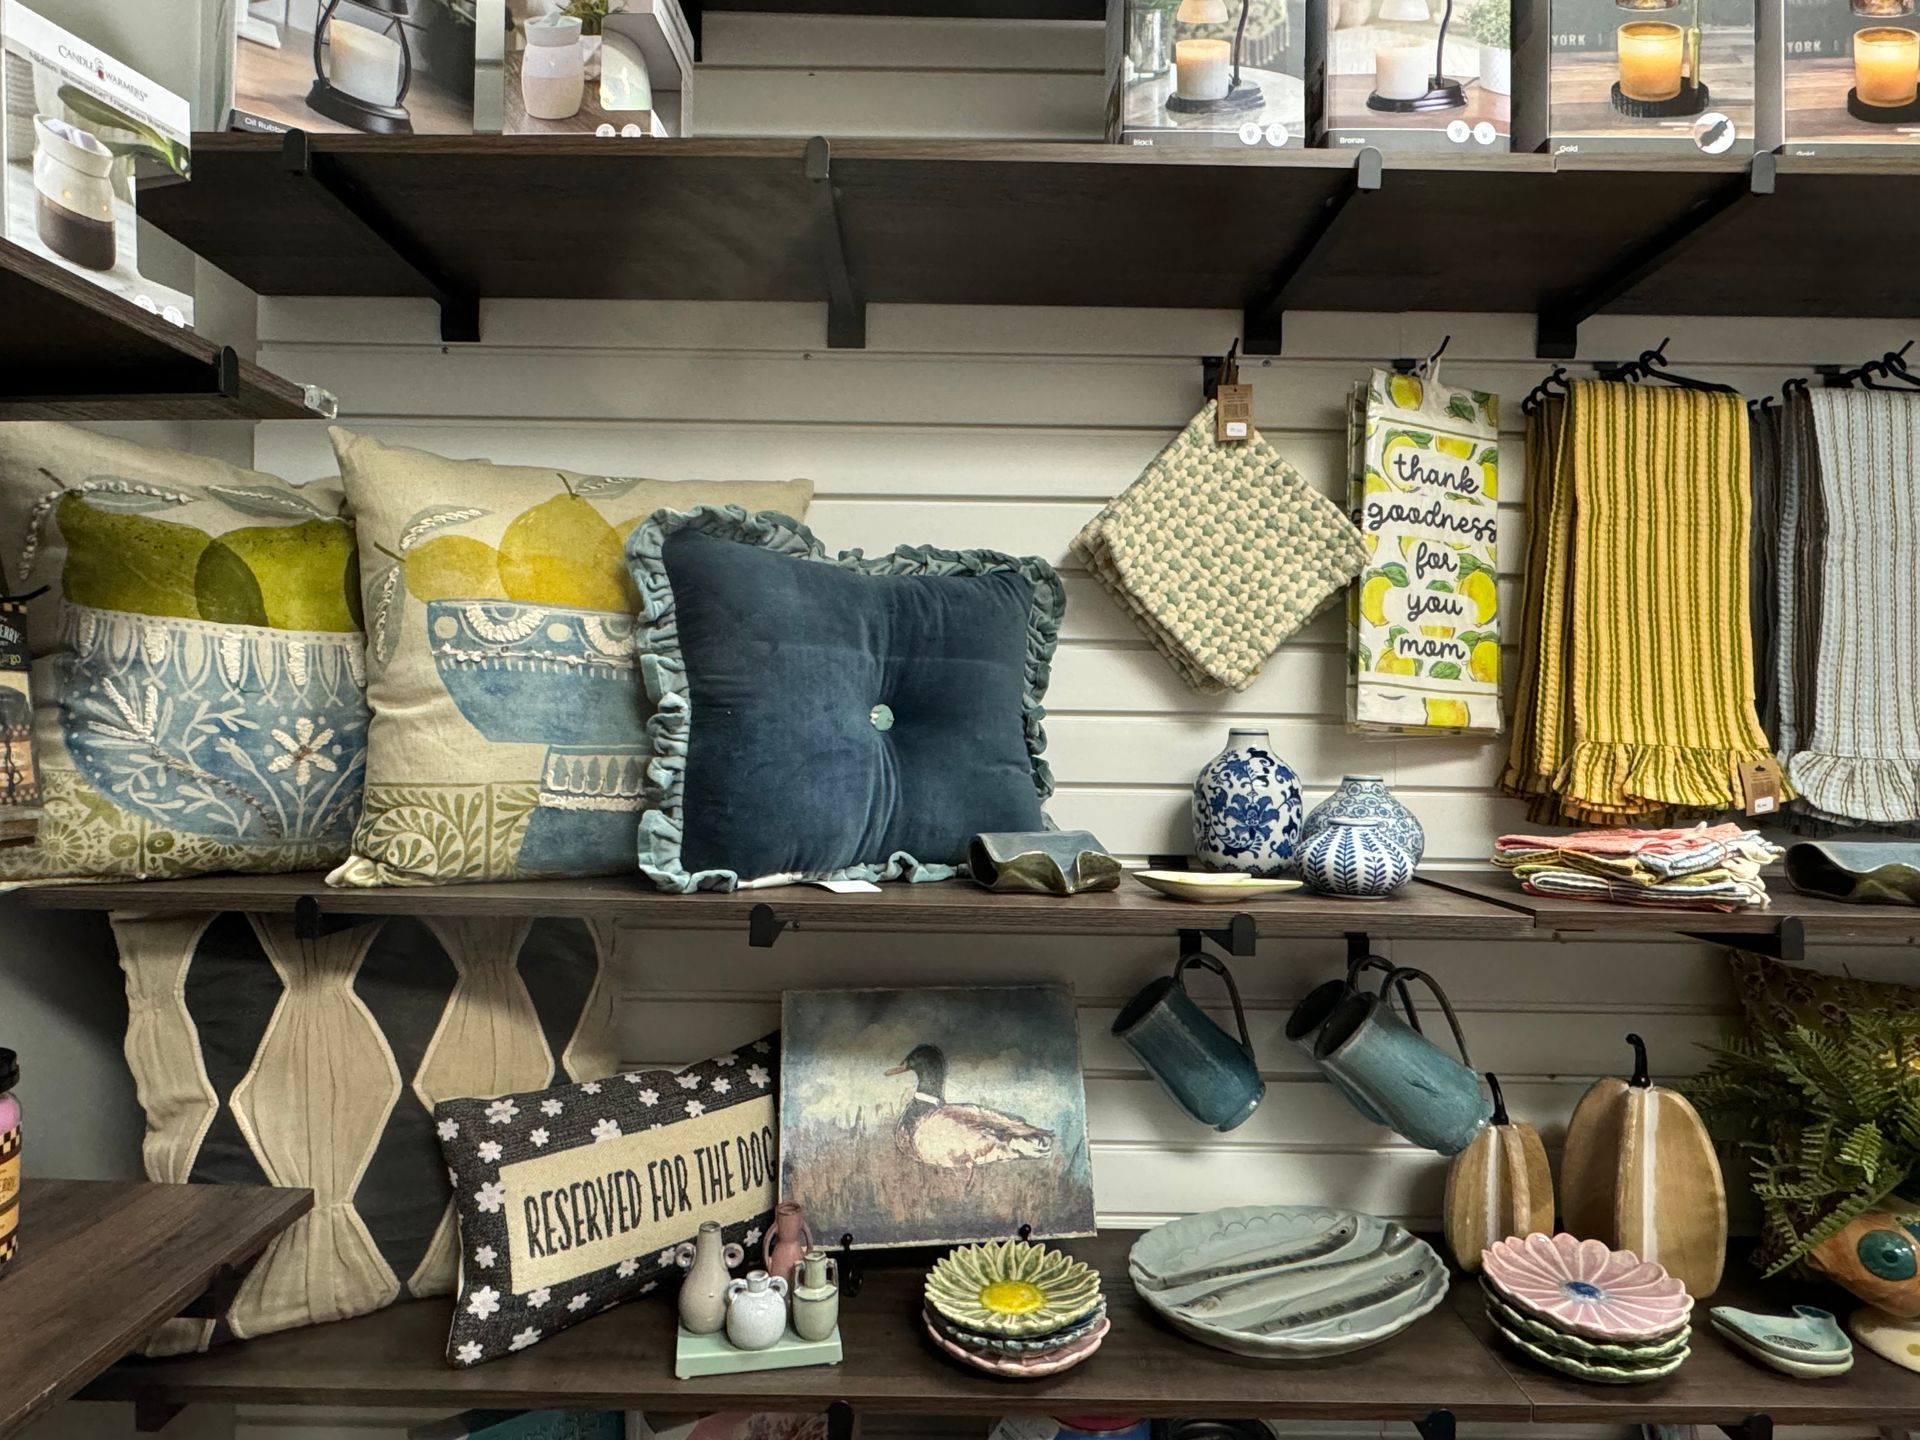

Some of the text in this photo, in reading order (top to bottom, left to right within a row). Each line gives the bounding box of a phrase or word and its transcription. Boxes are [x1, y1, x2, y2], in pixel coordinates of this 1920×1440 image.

[1551, 33, 1586, 46] YORK
[1786, 40, 1821, 53] YORK
[58, 45, 146, 102] CANDLE WARMERS
[245, 117, 257, 126] Oil
[1133, 138, 1153, 146] Black
[1394, 454, 1479, 495] thank
[1367, 501, 1497, 544] goodness
[1416, 541, 1460, 580] for
[1407, 592, 1463, 622] you
[1399, 635, 1465, 660] mom
[523, 1168, 643, 1259] RESERVED
[647, 1154, 692, 1222] FOR
[693, 1140, 736, 1206] THE
